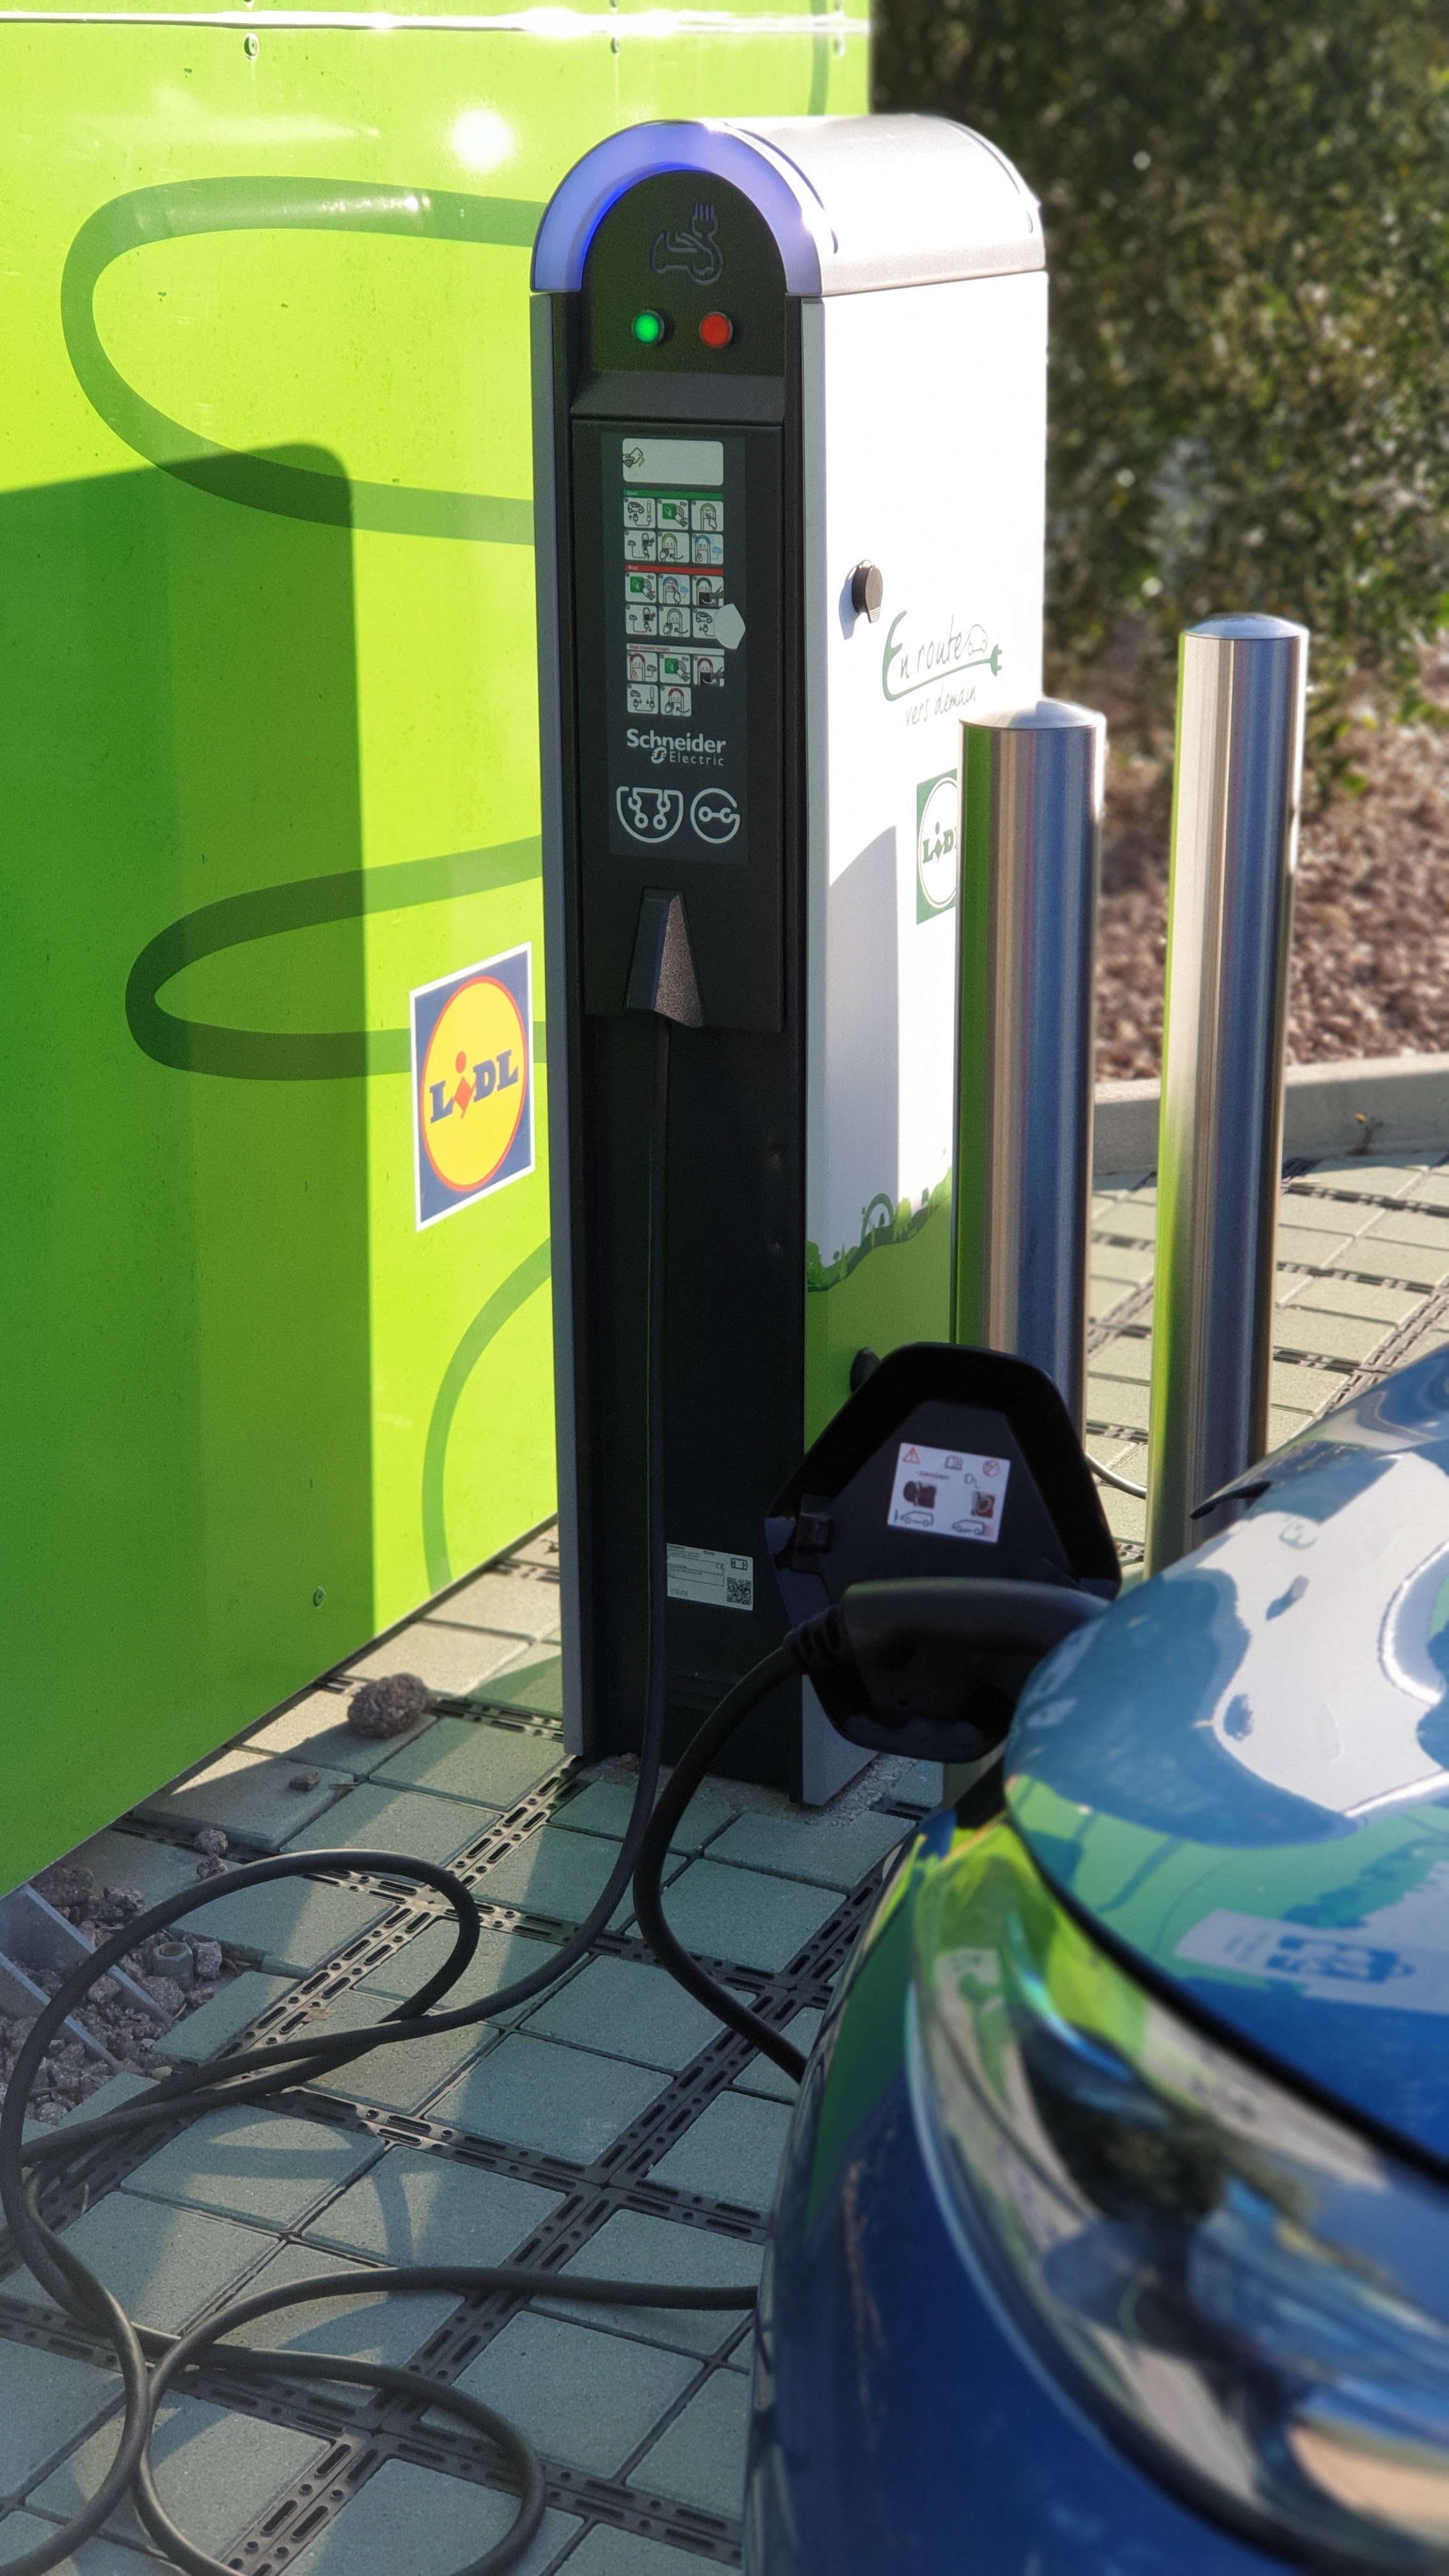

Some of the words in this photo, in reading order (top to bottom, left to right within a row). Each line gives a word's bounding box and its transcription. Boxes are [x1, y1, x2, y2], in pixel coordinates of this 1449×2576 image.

[917, 613, 962, 673] route
[934, 680, 976, 716] demain
[626, 728, 726, 753] Schneider
[670, 751, 724, 766] Electric
